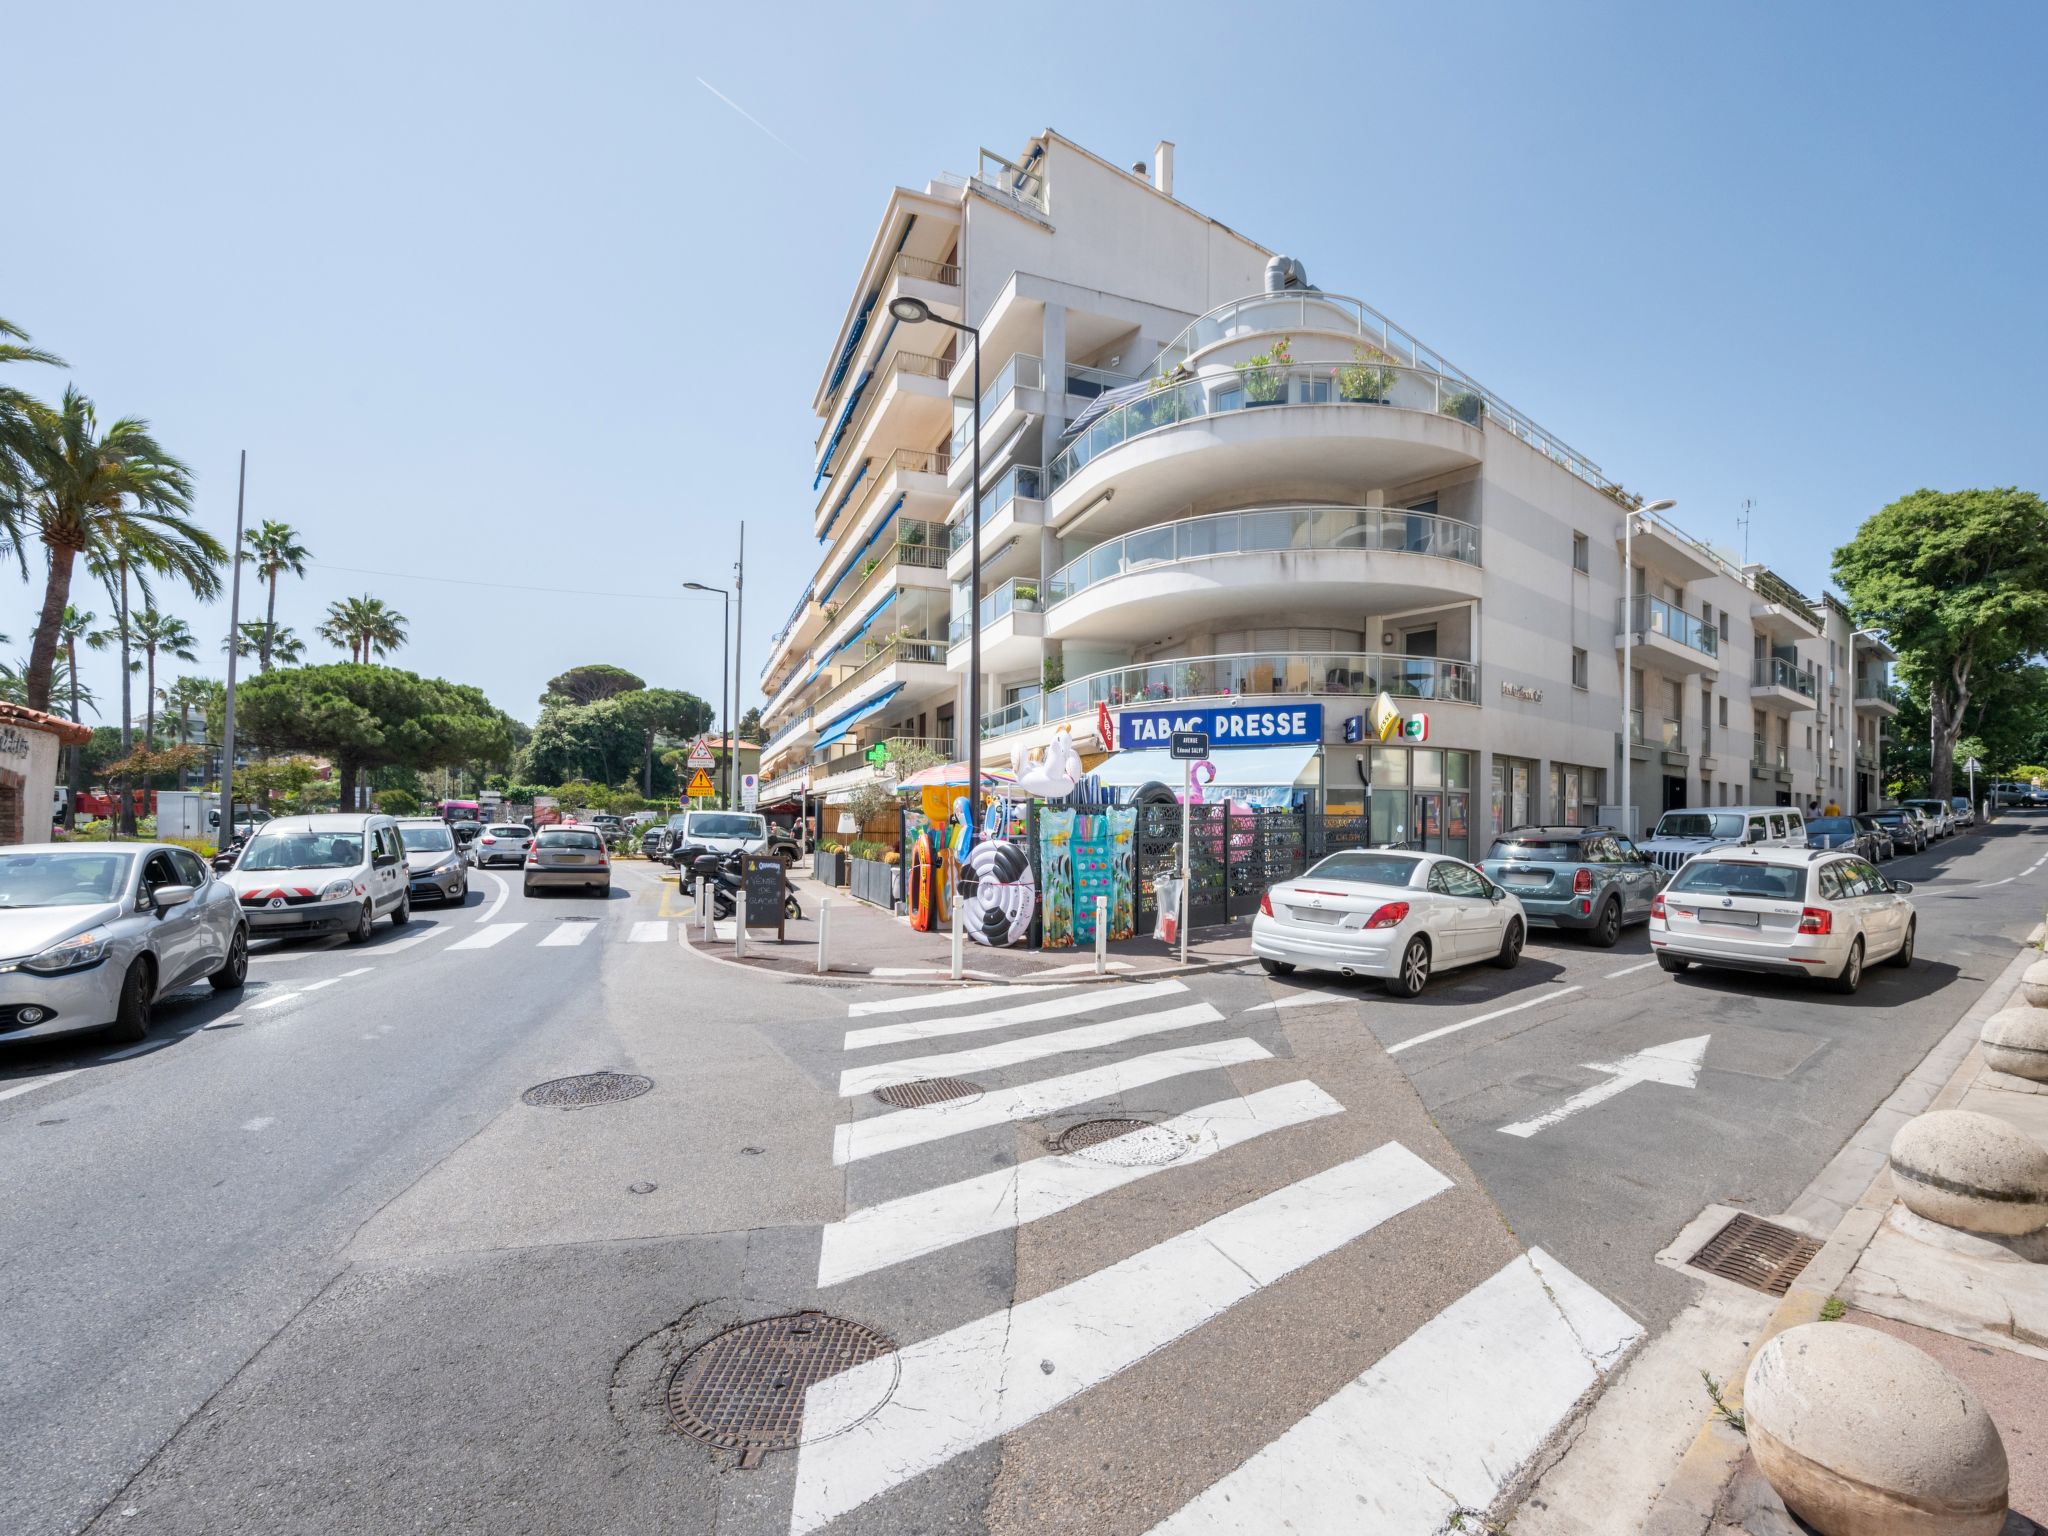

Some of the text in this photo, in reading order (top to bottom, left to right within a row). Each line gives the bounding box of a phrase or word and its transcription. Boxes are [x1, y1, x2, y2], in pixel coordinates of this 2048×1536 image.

[1102, 712, 1112, 741] TABAC
[1131, 711, 1307, 740] TABAC PRESSE
